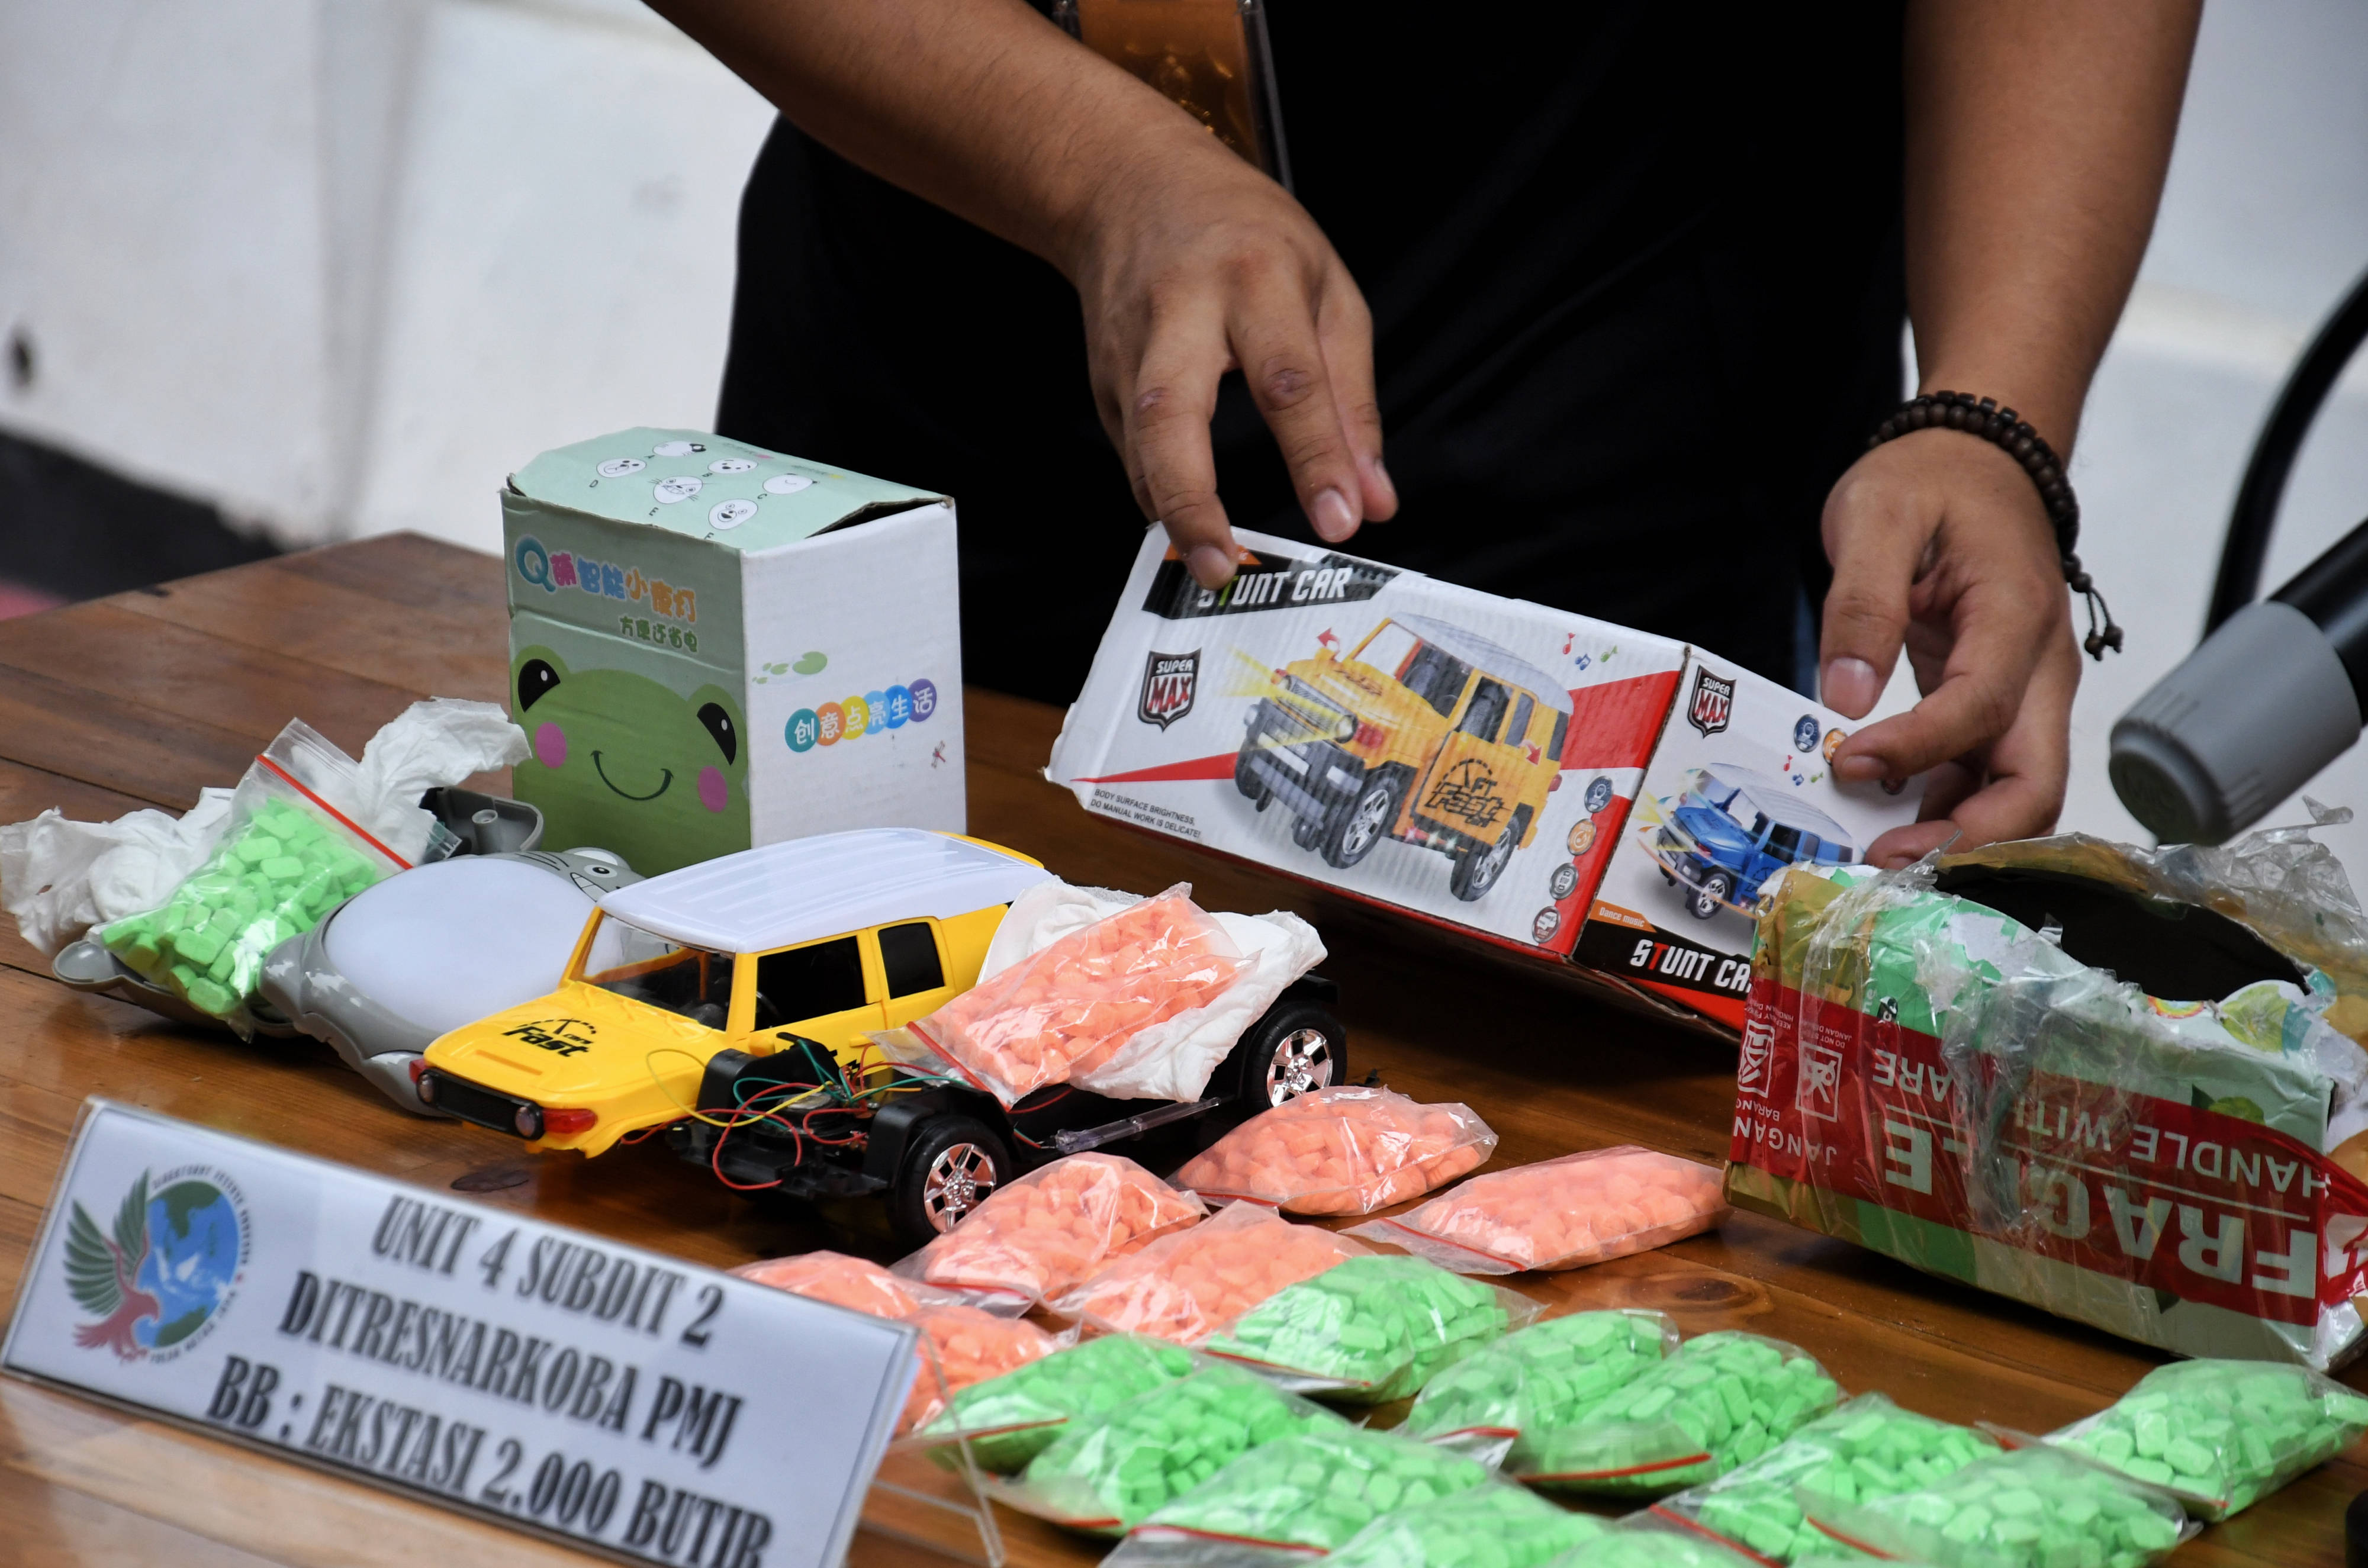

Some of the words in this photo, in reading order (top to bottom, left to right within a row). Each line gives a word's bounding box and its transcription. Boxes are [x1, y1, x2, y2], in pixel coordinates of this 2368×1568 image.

[1292, 567, 1353, 601] CAR
[1156, 659, 1194, 674] SUPER
[1147, 676, 1191, 712] MAX
[1703, 677, 1731, 696] SUPER
[794, 687, 934, 745] 创意点亮生活
[1694, 689, 1729, 723] MAX
[1090, 799, 1102, 808] DO
[1102, 802, 1132, 818] MANUAL
[1133, 811, 1156, 825] WORK
[1156, 818, 1164, 827] IS
[1094, 788, 1115, 800] BODY
[1116, 794, 1149, 811] SURFACE
[1149, 804, 1195, 826] BRIGHTNESS,
[1630, 939, 1716, 982] STUNT
[1714, 959, 1752, 994] CA
[501, 1026, 589, 1057] Fast
[1820, 1035, 1835, 1045] NOT
[1825, 1027, 1853, 1042] JANGAN
[1835, 1039, 1846, 1049] DO
[1872, 1048, 1955, 1103] ARE
[1733, 1116, 1838, 1166] JANGAN
[2130, 1124, 2330, 1198] HANDLE
[372, 1193, 481, 1276] UNIT
[478, 1226, 520, 1287] 4
[516, 1233, 688, 1336] SUBDIT
[679, 1282, 727, 1350] 2
[276, 1269, 639, 1435] DITRESNARKOBA
[639, 1372, 745, 1470] PMJ
[206, 1354, 281, 1428] BB
[304, 1383, 488, 1494] EKSTASI
[480, 1436, 623, 1536] 2.000
[622, 1477, 776, 1567] BUTIR
